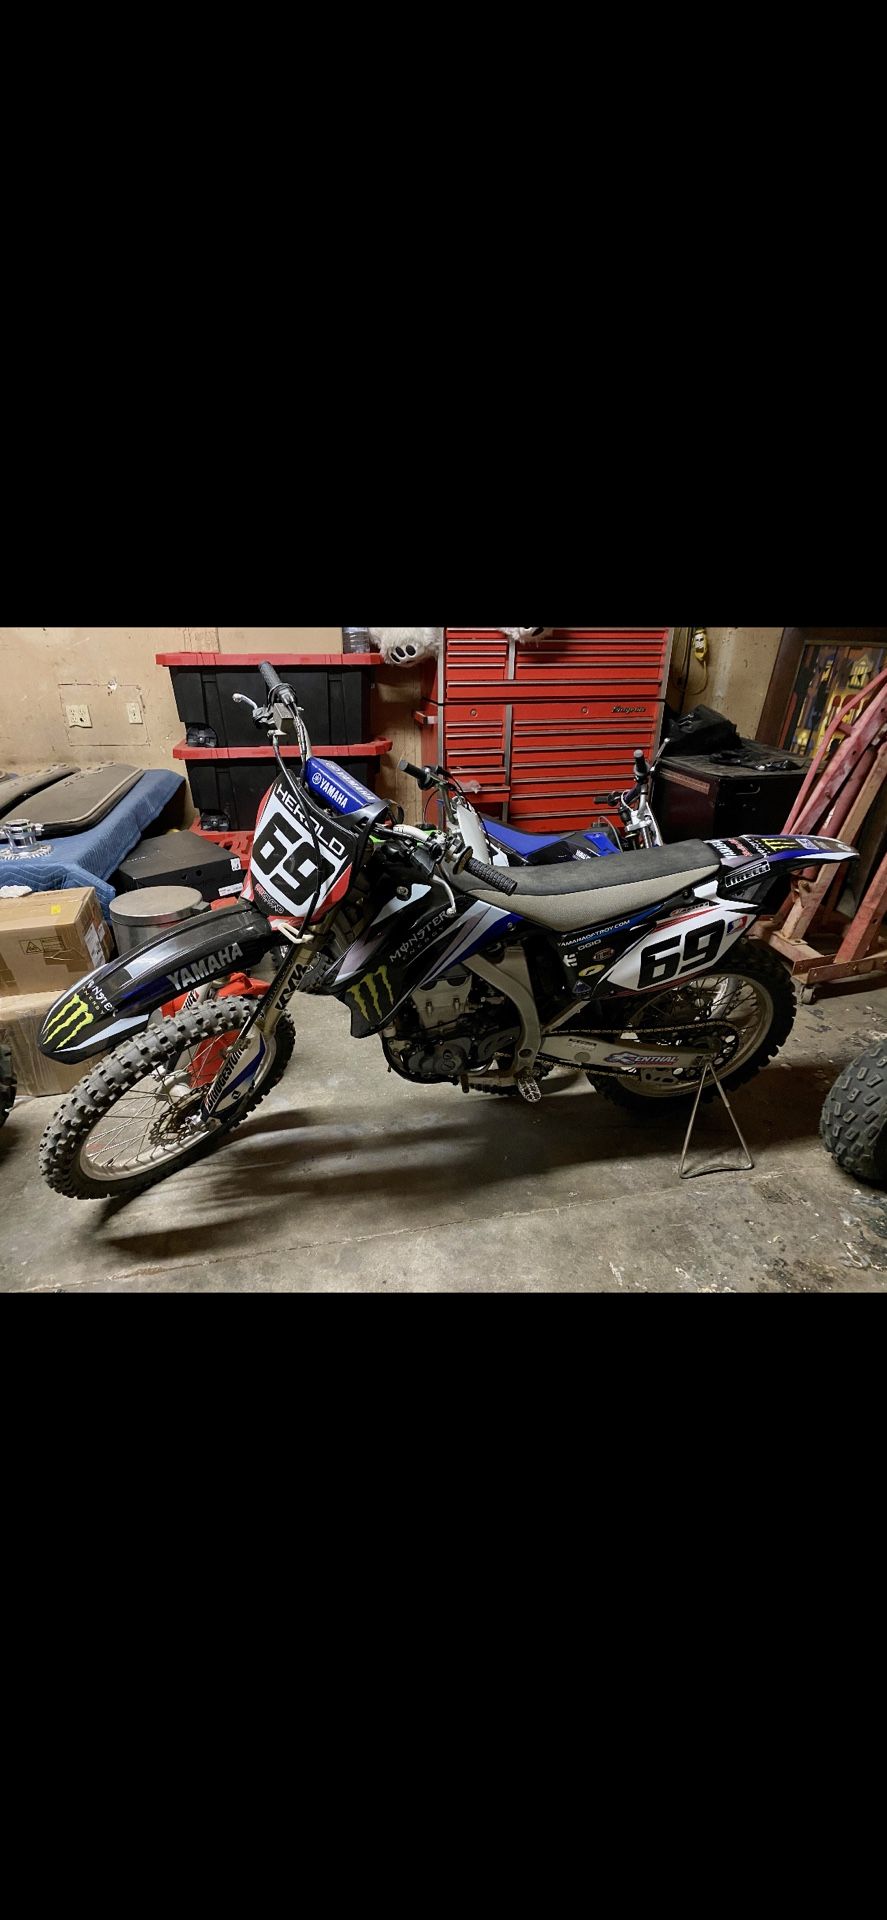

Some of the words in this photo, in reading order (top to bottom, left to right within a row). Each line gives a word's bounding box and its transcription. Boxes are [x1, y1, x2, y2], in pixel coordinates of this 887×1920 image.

[319, 777, 349, 808] YAMAHA
[251, 811, 336, 907] 69
[165, 942, 244, 991] YAMAHA
[636, 918, 726, 989] 69
